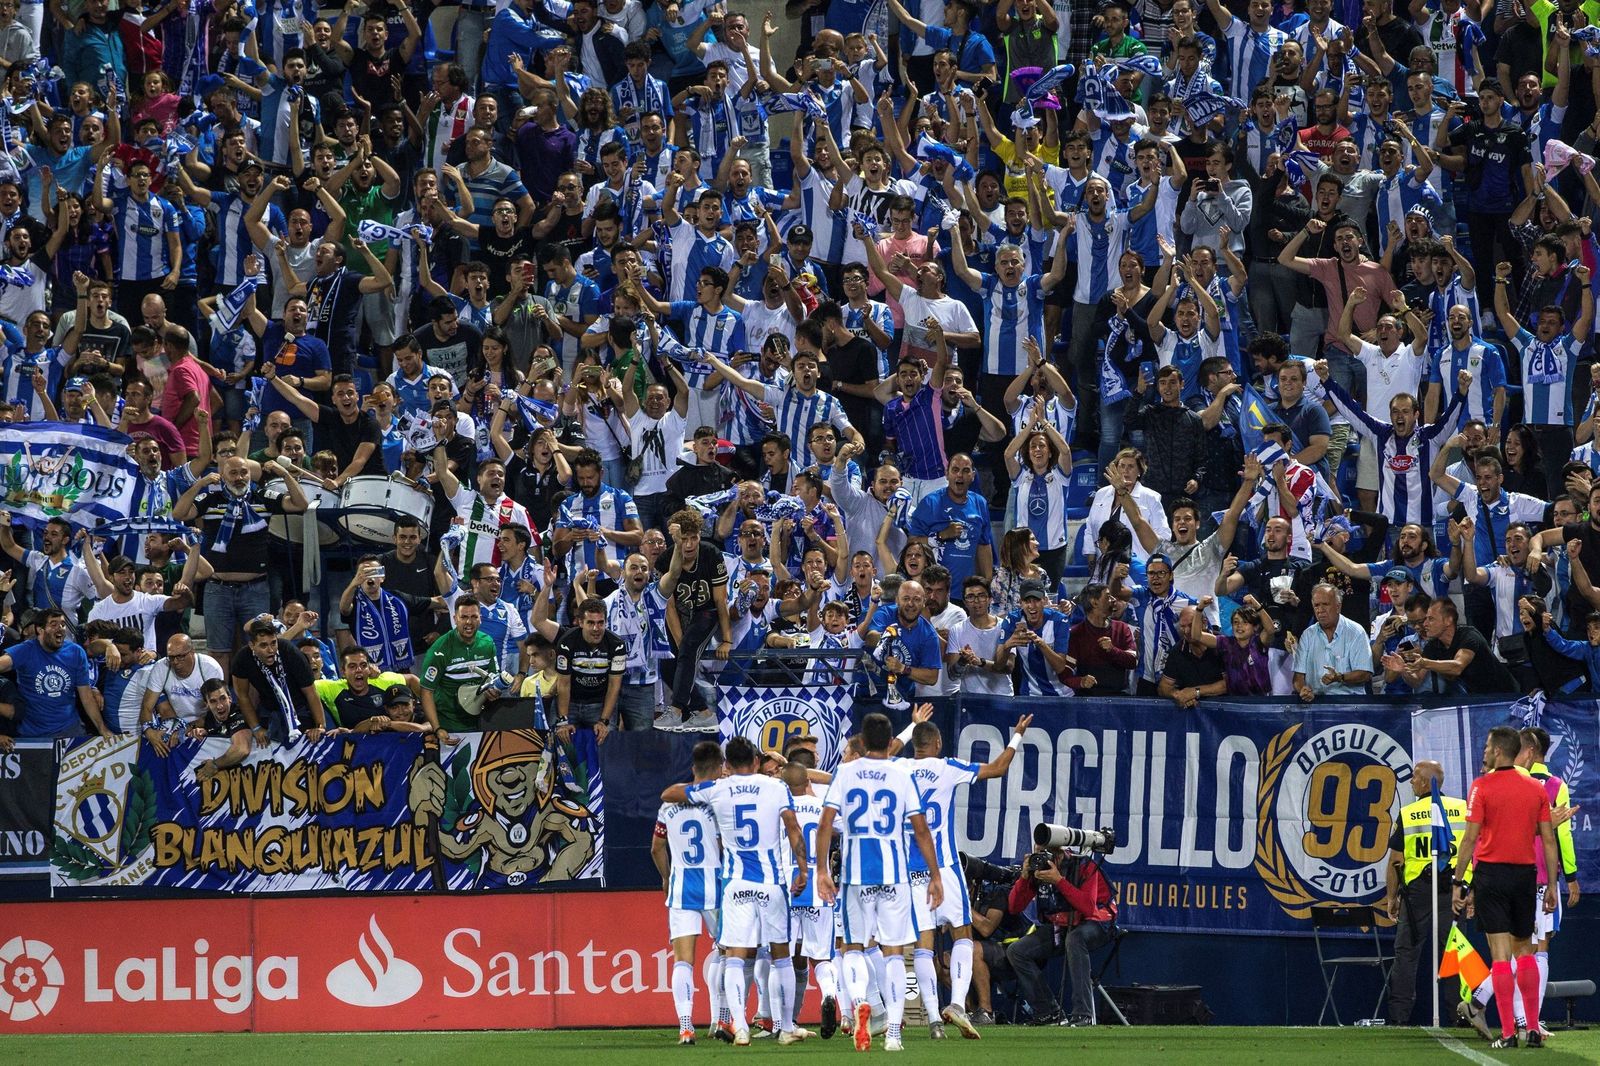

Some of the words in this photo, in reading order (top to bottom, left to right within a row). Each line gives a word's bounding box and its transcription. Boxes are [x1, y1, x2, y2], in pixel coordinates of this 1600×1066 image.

[487, 239, 523, 257] Wrangler
[438, 352, 457, 361] SUN
[470, 520, 501, 537] betwa
[753, 700, 818, 727] ORGULLO
[1296, 727, 1413, 784] ORGULLO
[199, 739, 385, 818] DIVISIÓN
[856, 770, 887, 782] VESGA
[912, 769, 939, 784] ESYRI
[667, 800, 709, 819] BUSA
[846, 788, 898, 836] 23
[905, 788, 942, 830] 6
[954, 724, 1260, 868] ORGULLO
[1301, 762, 1397, 863] 93
[734, 803, 759, 849] 5
[1410, 809, 1460, 821] SEGUAD
[0, 829, 46, 855] NO
[151, 821, 435, 874] BLANQUIAZUL
[681, 819, 705, 866] 3
[101, 857, 153, 886] GANÉS
[1309, 865, 1378, 894] 2010
[84, 938, 299, 1014] LaLiga
[443, 927, 817, 997] Santa
